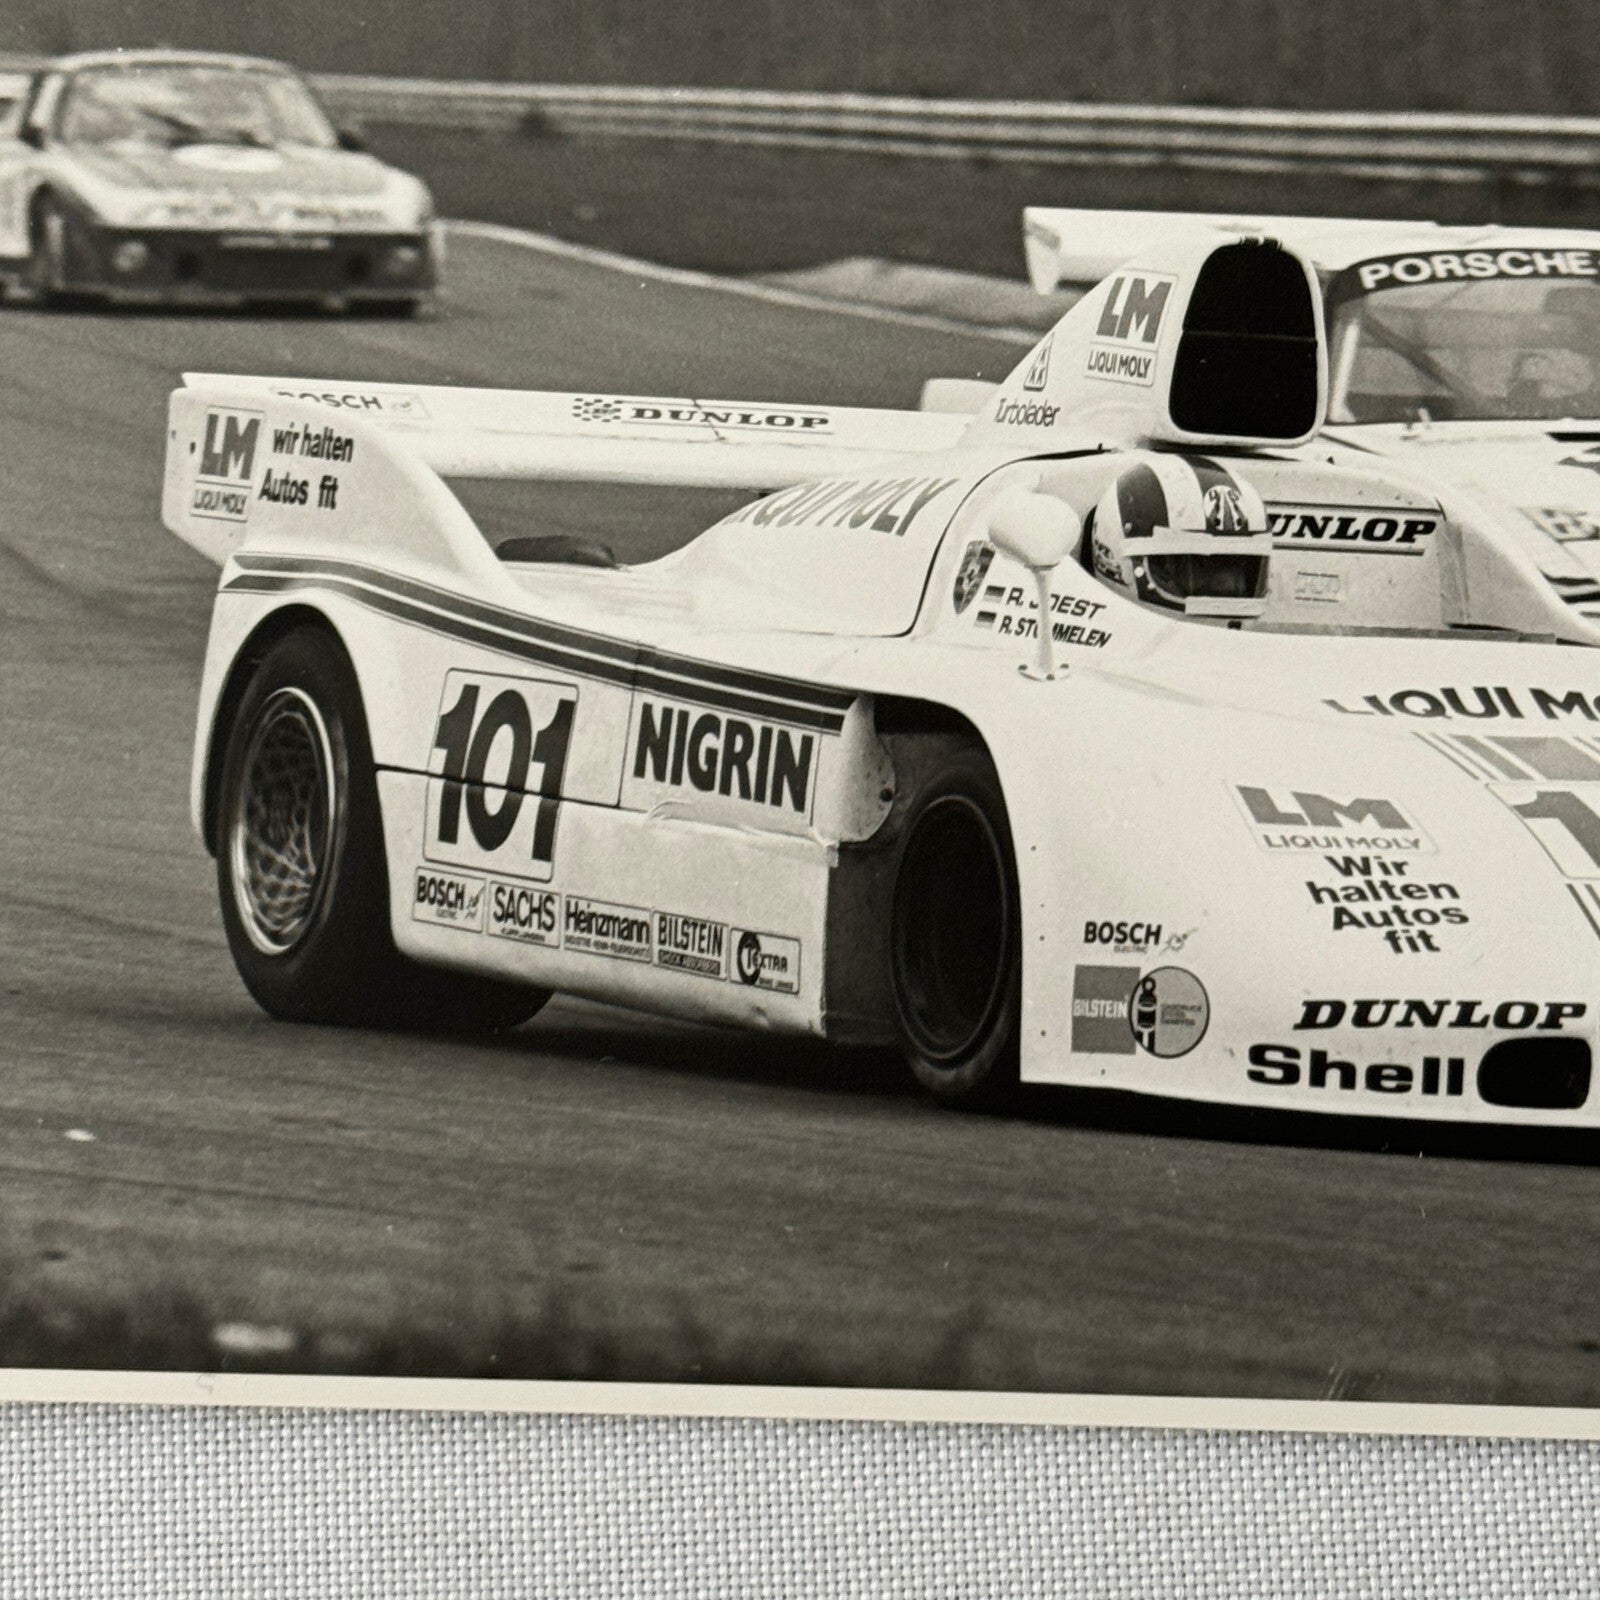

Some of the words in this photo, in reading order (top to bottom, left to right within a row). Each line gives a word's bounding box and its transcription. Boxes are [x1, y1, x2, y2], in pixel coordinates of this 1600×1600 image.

[1359, 251, 1599, 290] PORSCHE
[1096, 276, 1173, 345] LM
[1087, 350, 1117, 374] LIQUI
[1118, 354, 1152, 379] MOLY
[277, 391, 382, 410] SCH
[630, 406, 829, 429] DUNLOP
[199, 413, 261, 481] LM
[300, 423, 354, 463] halten
[258, 468, 309, 506] Autos
[317, 474, 339, 510] fit
[1267, 513, 1437, 543] UNLOP
[1321, 686, 1525, 719] LIQUI
[1528, 687, 1600, 722] M
[434, 684, 577, 861] 101
[633, 702, 814, 813] NIGRIN
[1235, 784, 1414, 830] LM
[1263, 834, 1342, 850] LIQUI
[1348, 836, 1422, 851] MOLY
[1324, 855, 1409, 877] Wir
[416, 875, 467, 911] BOSCH
[493, 886, 556, 932] SACHS
[1305, 879, 1460, 904] halten
[565, 900, 650, 945] Heinzmann
[658, 914, 723, 957] BILSTEIN
[1083, 920, 1163, 946] BOSCH
[1333, 905, 1469, 931] Autos
[1384, 929, 1441, 954] fit
[1073, 999, 1129, 1019] BILSTEIN
[1293, 999, 1587, 1031] DUNLOP
[1247, 1043, 1464, 1096] Shell
